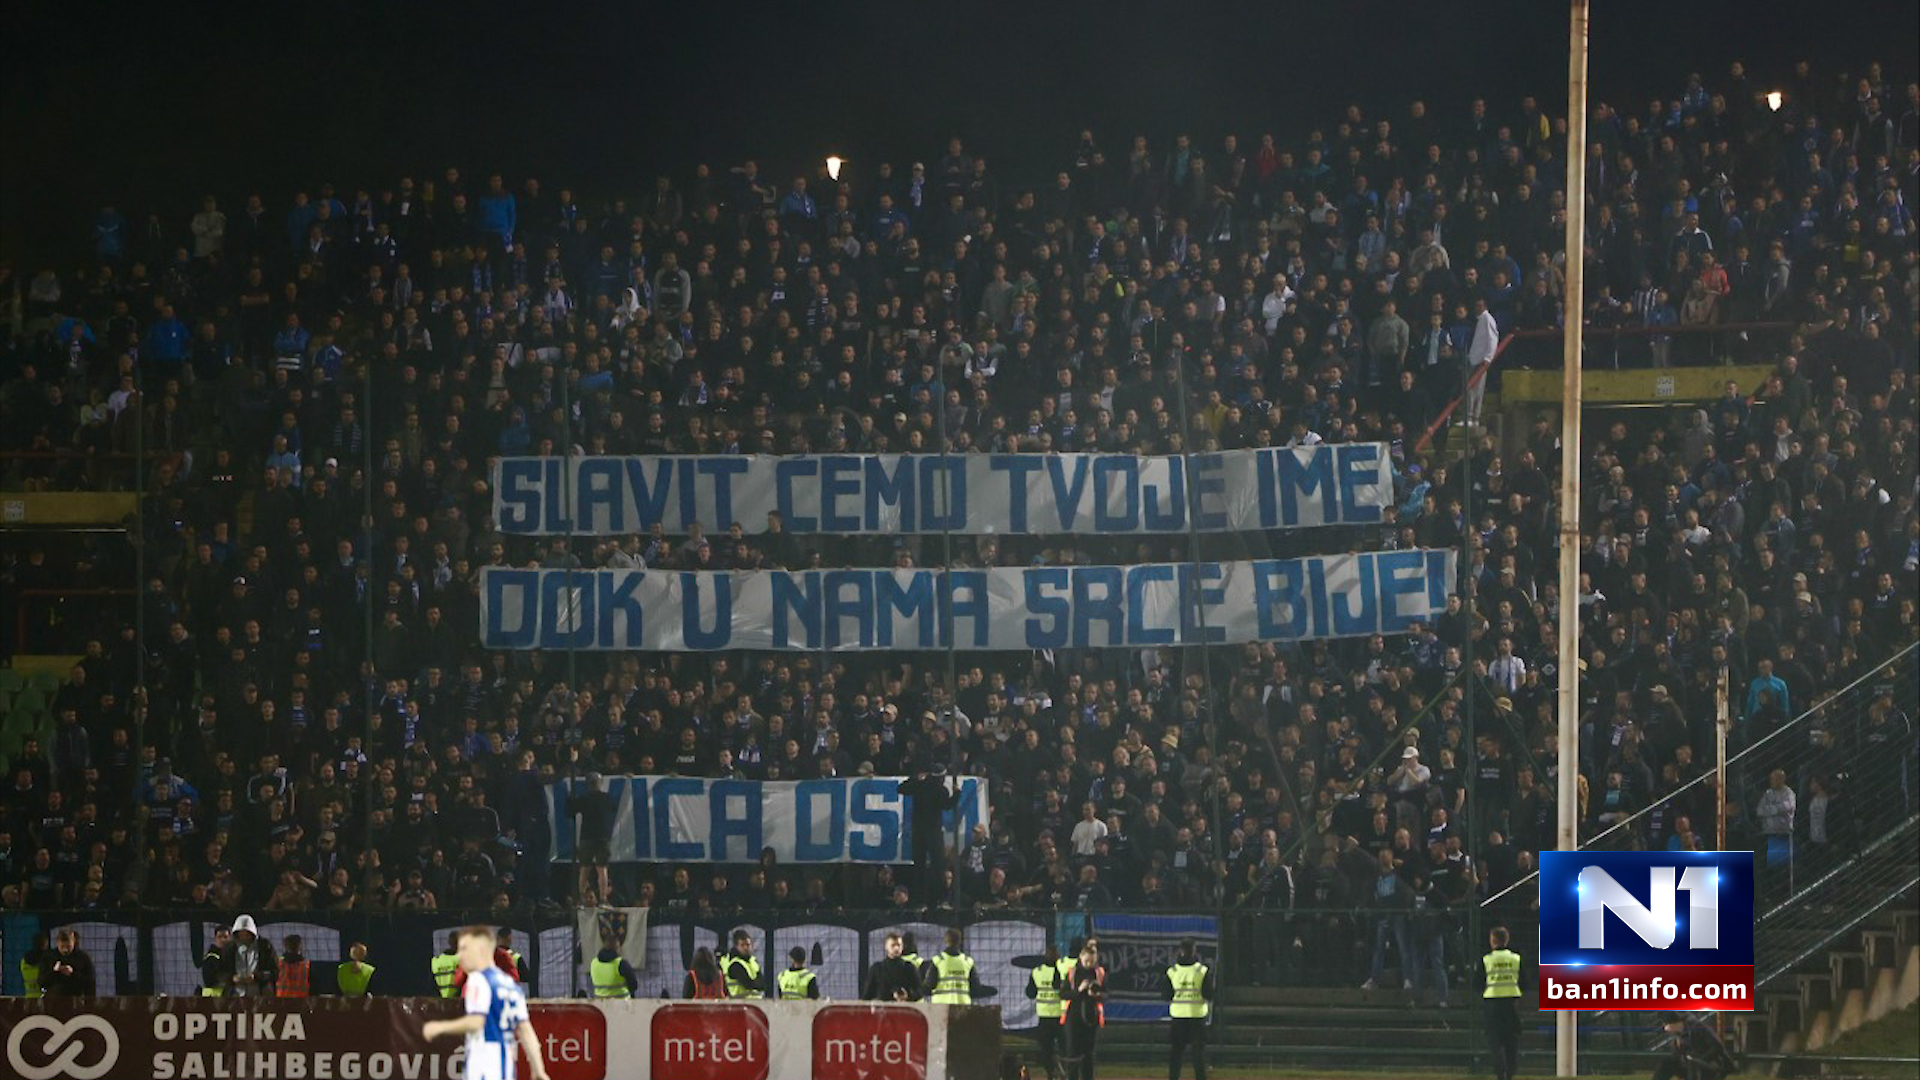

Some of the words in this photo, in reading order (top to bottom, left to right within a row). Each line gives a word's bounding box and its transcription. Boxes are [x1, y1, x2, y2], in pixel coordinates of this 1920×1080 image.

[501, 457, 750, 533] SLAVIT
[990, 453, 1227, 533] TVOJE
[1256, 445, 1381, 527] IME
[486, 571, 645, 648] DOK
[680, 571, 732, 649] U
[771, 571, 988, 648] NAMA
[1024, 563, 1227, 649] SRCE
[1253, 550, 1445, 639] BIJE!
[153, 1012, 306, 1041] OPTIKA
[545, 1028, 592, 1063] tel
[664, 1028, 756, 1063] m:tel
[825, 1031, 915, 1065] m:tel
